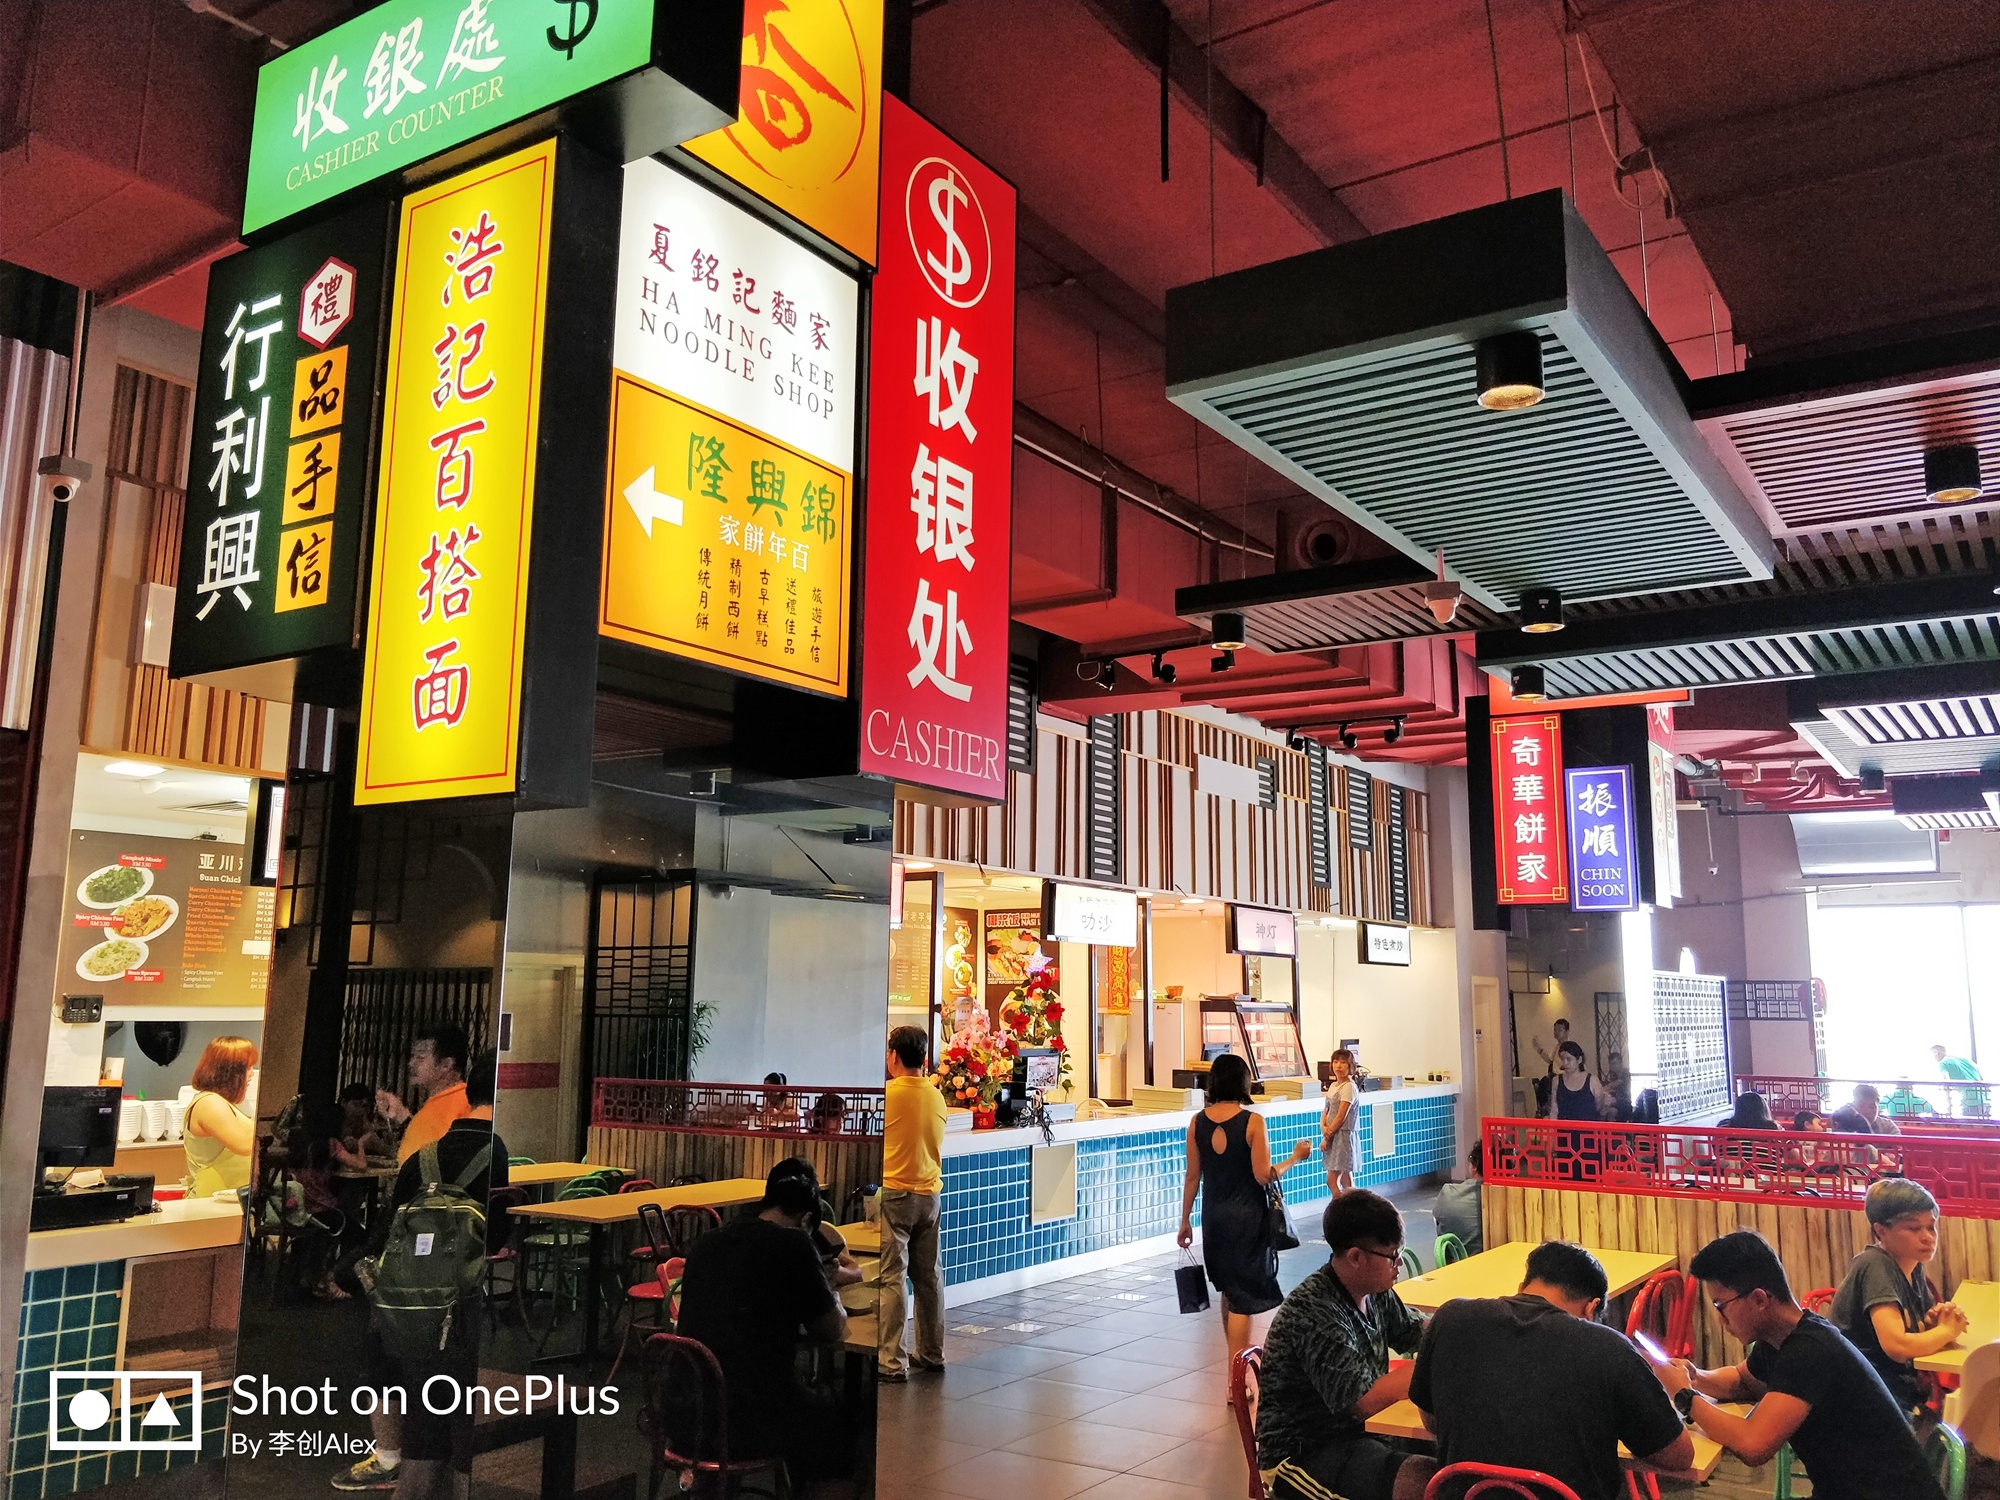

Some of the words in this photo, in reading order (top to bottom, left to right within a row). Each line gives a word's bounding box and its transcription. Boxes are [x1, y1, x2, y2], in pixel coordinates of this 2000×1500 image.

[285, 129, 380, 191] CASHIER
[387, 75, 505, 145] COUNTER
[292, 0, 507, 152] 收銀處
[641, 275, 681, 316] HA
[703, 306, 773, 361] MING
[791, 352, 835, 394] KEE
[648, 222, 831, 352] 夏銘記麵家
[639, 307, 755, 383] NOODLE
[773, 374, 835, 421] SHOP
[196, 293, 282, 622] 行利興
[410, 209, 504, 733] 浩記百搭面
[907, 315, 980, 703] 收银处
[695, 547, 713, 632] 傳統月餅
[866, 708, 1002, 782] CASHIER
[1510, 735, 1549, 883] 奇華餅家
[1578, 782, 1619, 857] 振順
[1082, 912, 1113, 933] 叻沙
[1255, 922, 1278, 940] 神灯
[1581, 867, 1622, 881] CHIN
[1581, 883, 1625, 897] SOON
